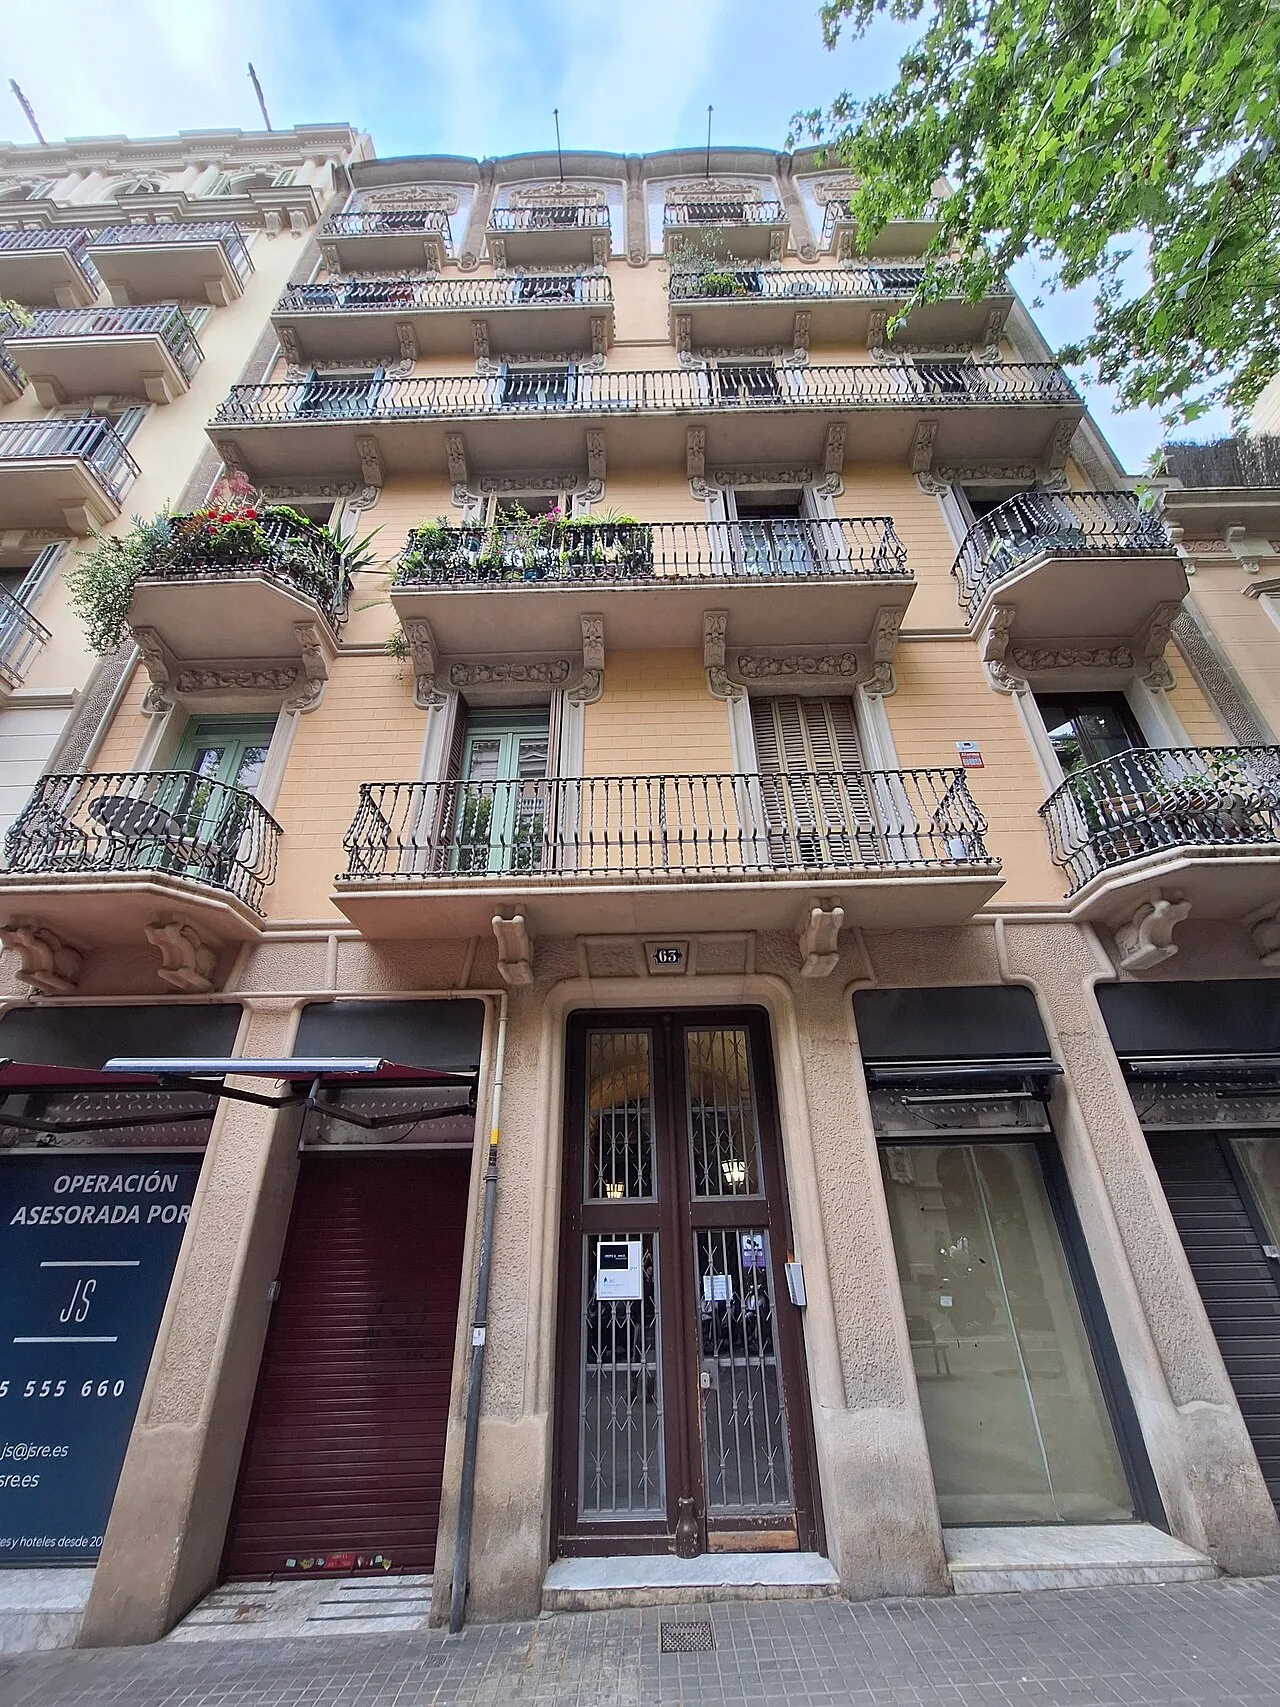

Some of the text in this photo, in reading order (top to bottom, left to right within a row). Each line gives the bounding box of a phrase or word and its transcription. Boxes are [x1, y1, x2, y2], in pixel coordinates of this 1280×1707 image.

[659, 949, 677, 962] 63
[54, 1170, 178, 1193] OPERACIÓN
[10, 1204, 192, 1225] ASESORADA POR
[59, 1279, 97, 1323] JS
[23, 1380, 67, 1397] 555
[81, 1379, 125, 1397] 660
[0, 1442, 69, 1461] js@jsre.es
[20, 1535, 56, 1547] hoteles
[57, 1535, 88, 1547] desde
